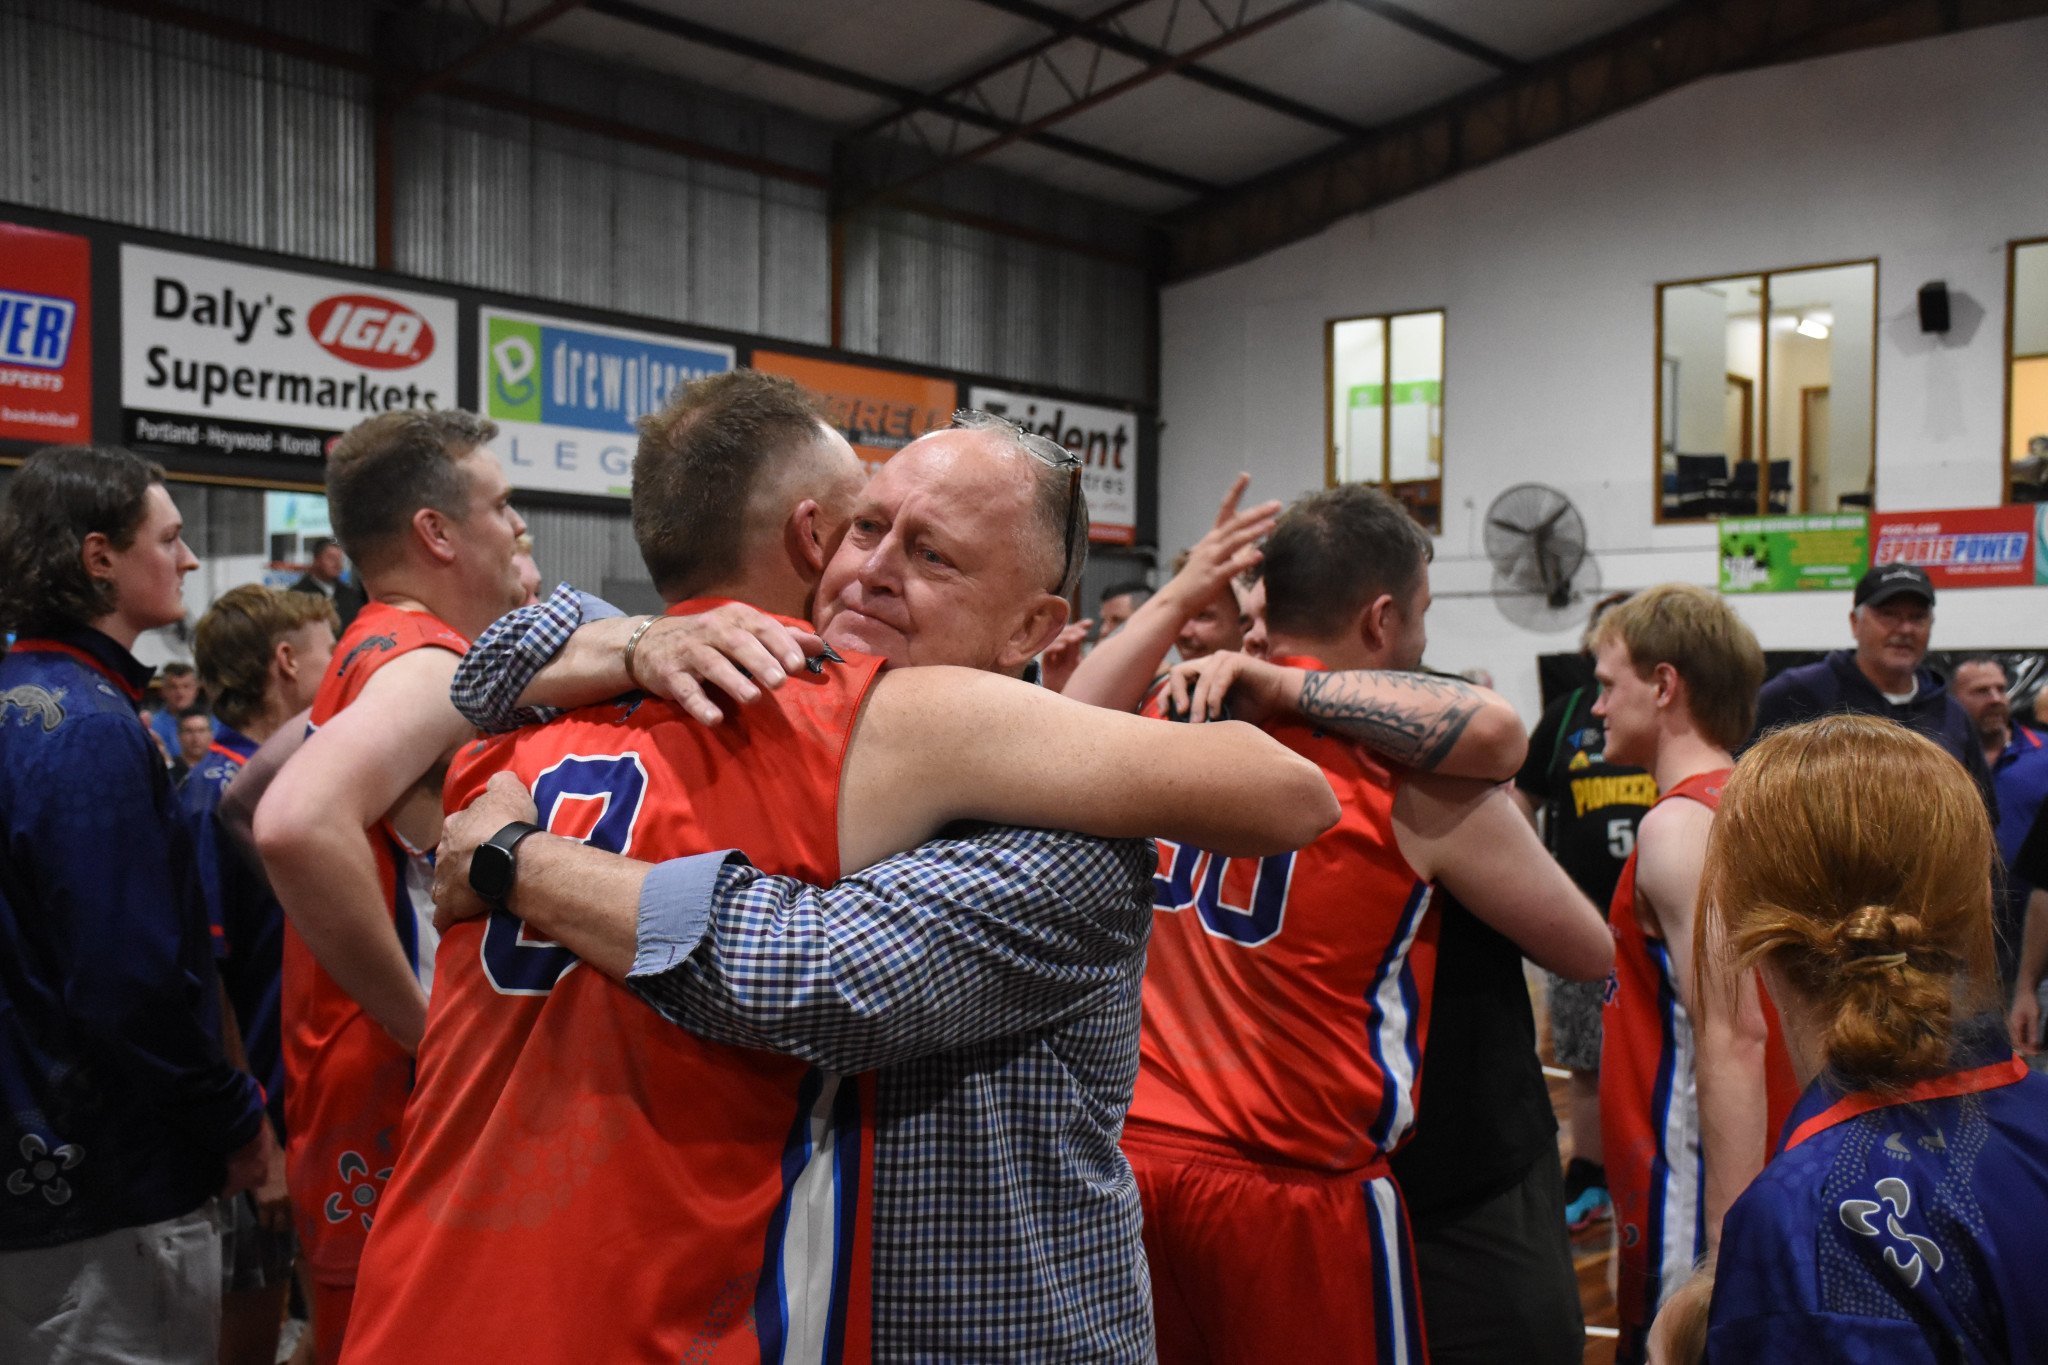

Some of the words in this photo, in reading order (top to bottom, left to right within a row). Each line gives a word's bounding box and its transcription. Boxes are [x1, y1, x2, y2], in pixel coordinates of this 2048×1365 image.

[0, 300, 65, 360] ER
[154, 276, 295, 343] Daly's
[320, 303, 423, 356] IGA
[146, 345, 439, 412] Supermarkets
[136, 416, 199, 445] Portland
[206, 425, 273, 454] Heywood
[1607, 819, 1635, 858] 5
